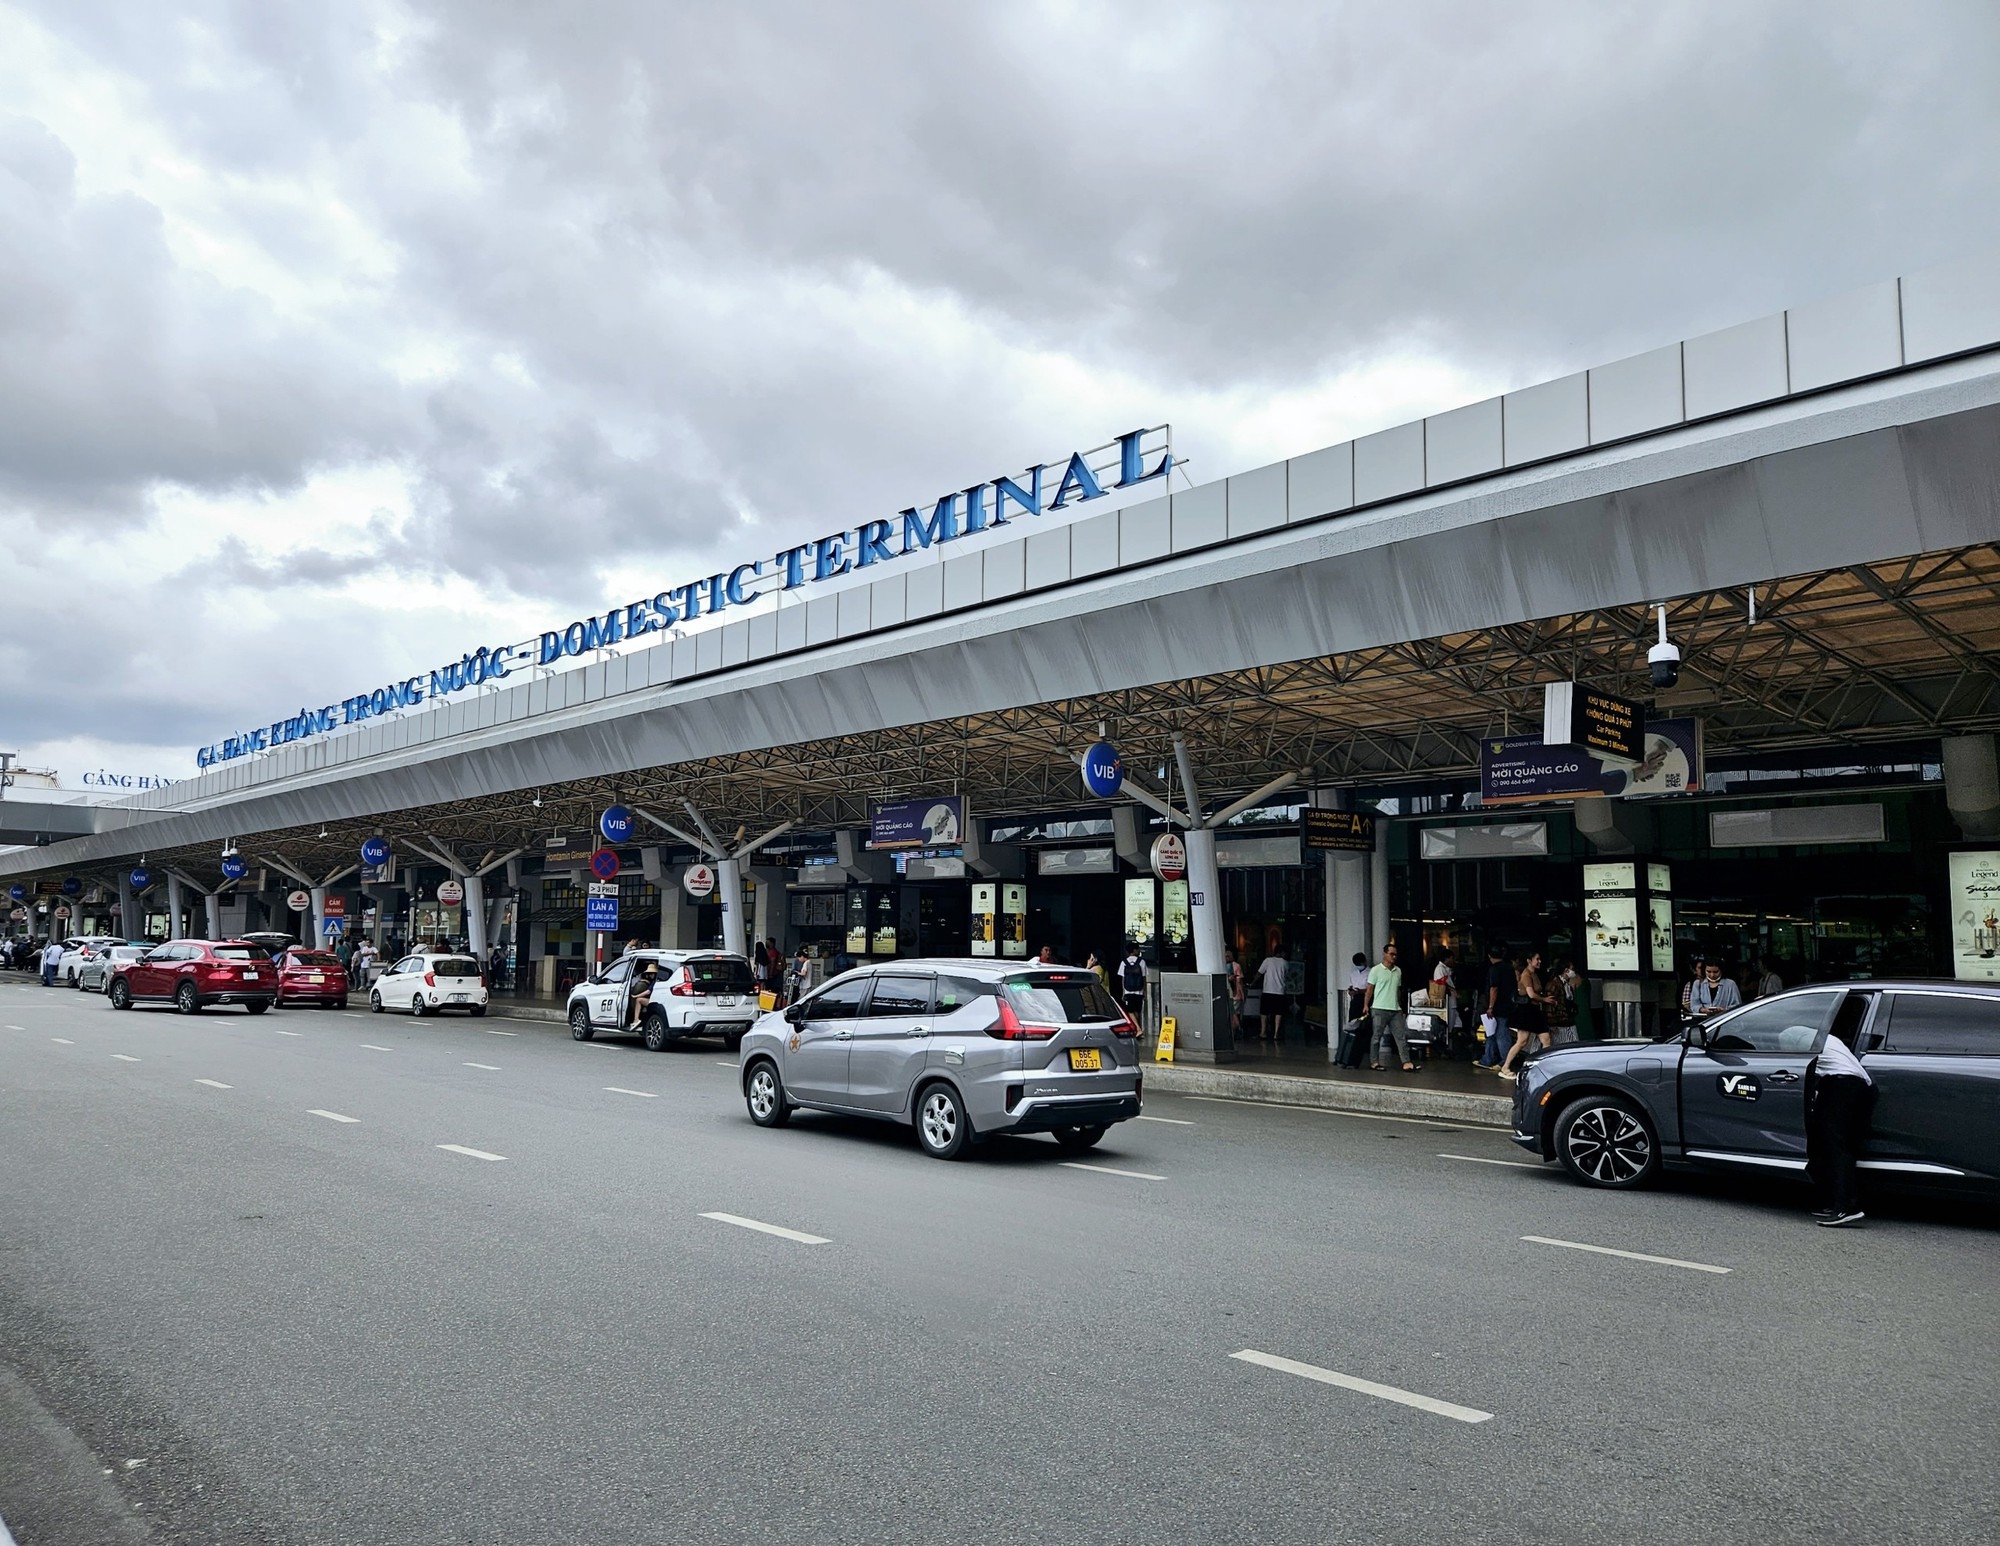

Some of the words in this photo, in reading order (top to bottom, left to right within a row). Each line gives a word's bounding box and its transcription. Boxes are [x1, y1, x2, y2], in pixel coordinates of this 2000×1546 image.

[196, 746, 217, 769] GA
[222, 729, 268, 755] HÀNG
[270, 707, 339, 747] KHÔNG
[342, 675, 424, 724] TRONG
[430, 645, 513, 698] NƯỚC
[538, 560, 762, 666] DOMESTIC
[775, 426, 1174, 590] TERMINAL
[1588, 696, 1598, 706] KHU
[1624, 706, 1632, 716] XE
[1586, 708, 1604, 720] KHÔNG
[1616, 717, 1619, 725] 3
[1620, 718, 1632, 728] PHÚT
[1596, 724, 1604, 732] Car
[1604, 726, 1622, 740] Parking
[1588, 734, 1608, 746] Maximum
[1612, 741, 1629, 752] Minutes
[1491, 760, 1526, 768] ADVERTISING
[1094, 764, 1115, 780] VIB
[1491, 768, 1512, 778] MỜI
[1514, 765, 1552, 778] QUẢNG
[1555, 763, 1579, 774] CÁO
[83, 768, 133, 789] CẢNG
[608, 820, 626, 830] VIB
[1351, 814, 1362, 834] A
[366, 848, 382, 856] VIB
[570, 850, 591, 860] Ginseng
[1971, 870, 1998, 879] Legend
[602, 886, 617, 894] PHÚT
[1190, 893, 1204, 904] -10
[592, 900, 606, 910] LÀN
[608, 903, 614, 911] A
[1078, 1049, 1092, 1059] 66E
[1075, 1059, 1098, 1068] 005.37
